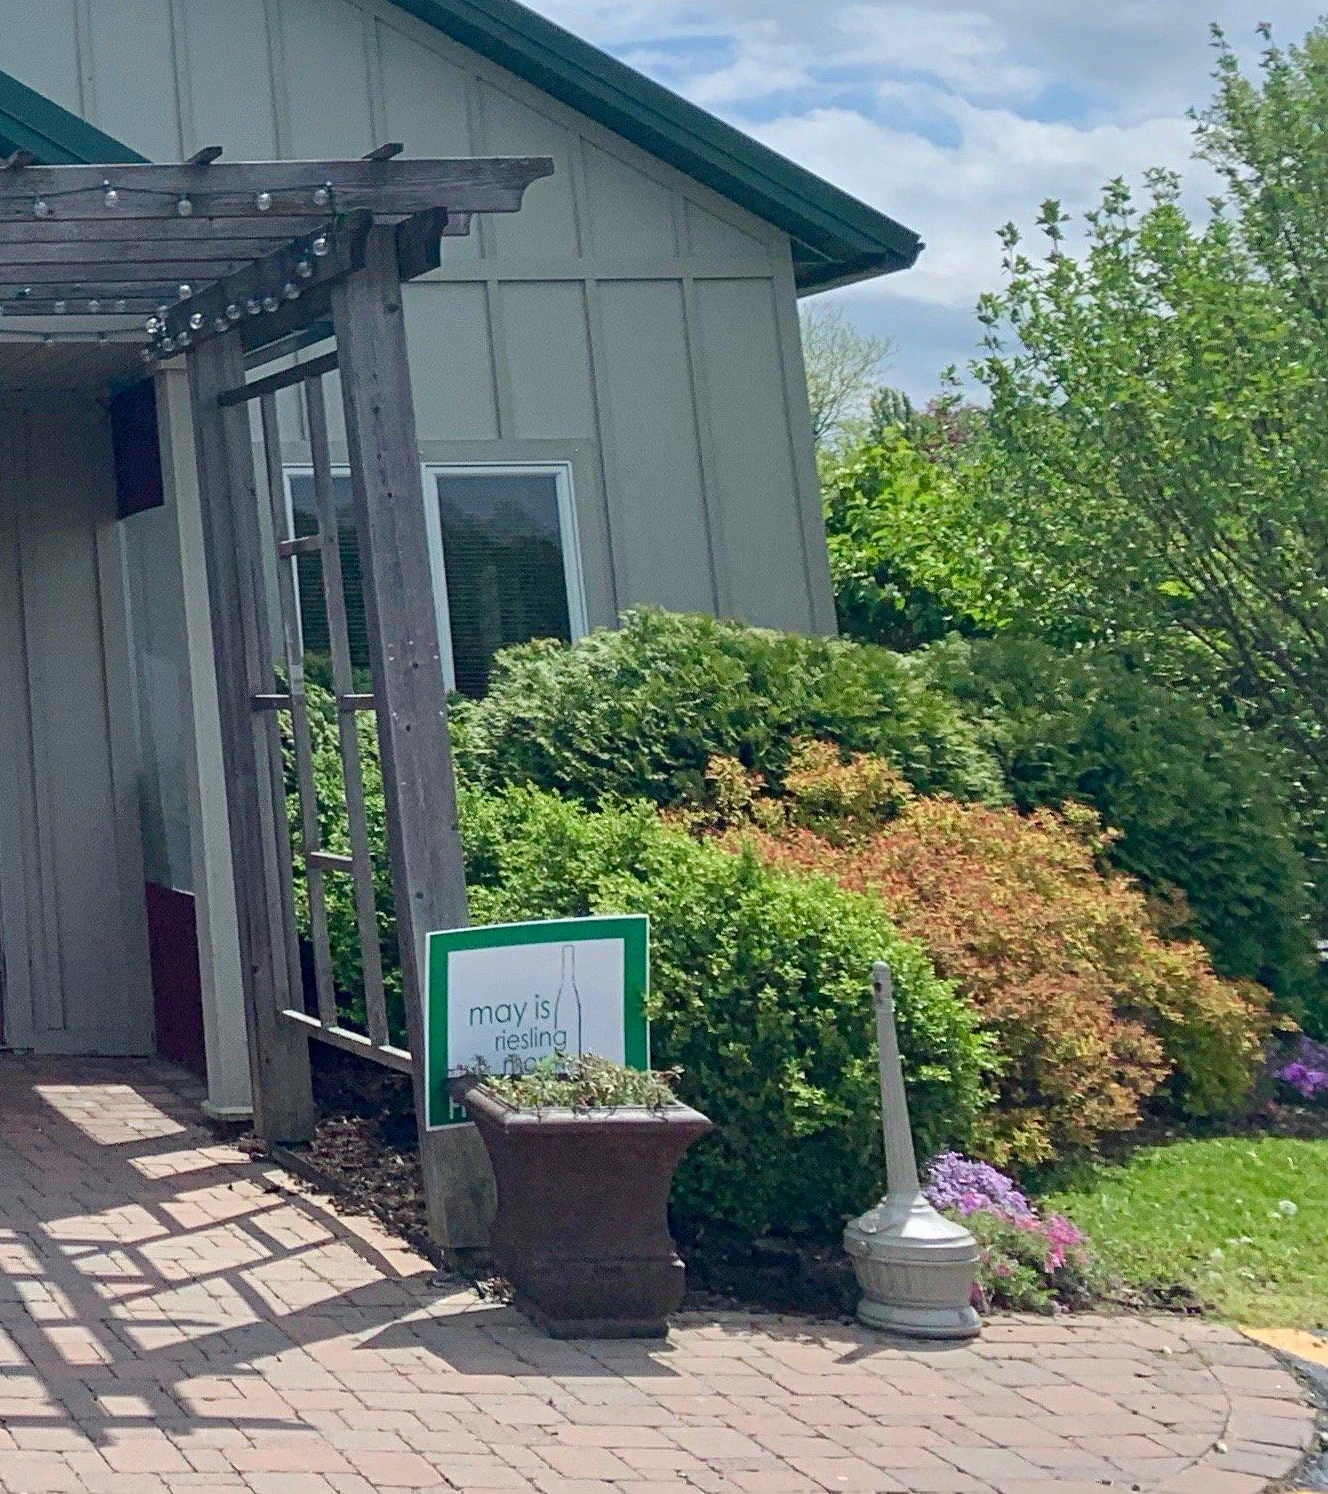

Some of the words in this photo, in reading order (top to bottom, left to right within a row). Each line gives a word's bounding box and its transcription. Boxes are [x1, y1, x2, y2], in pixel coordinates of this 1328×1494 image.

[469, 1001, 527, 1027] may
[534, 994, 550, 1019] is
[495, 1026, 567, 1053] riesling
